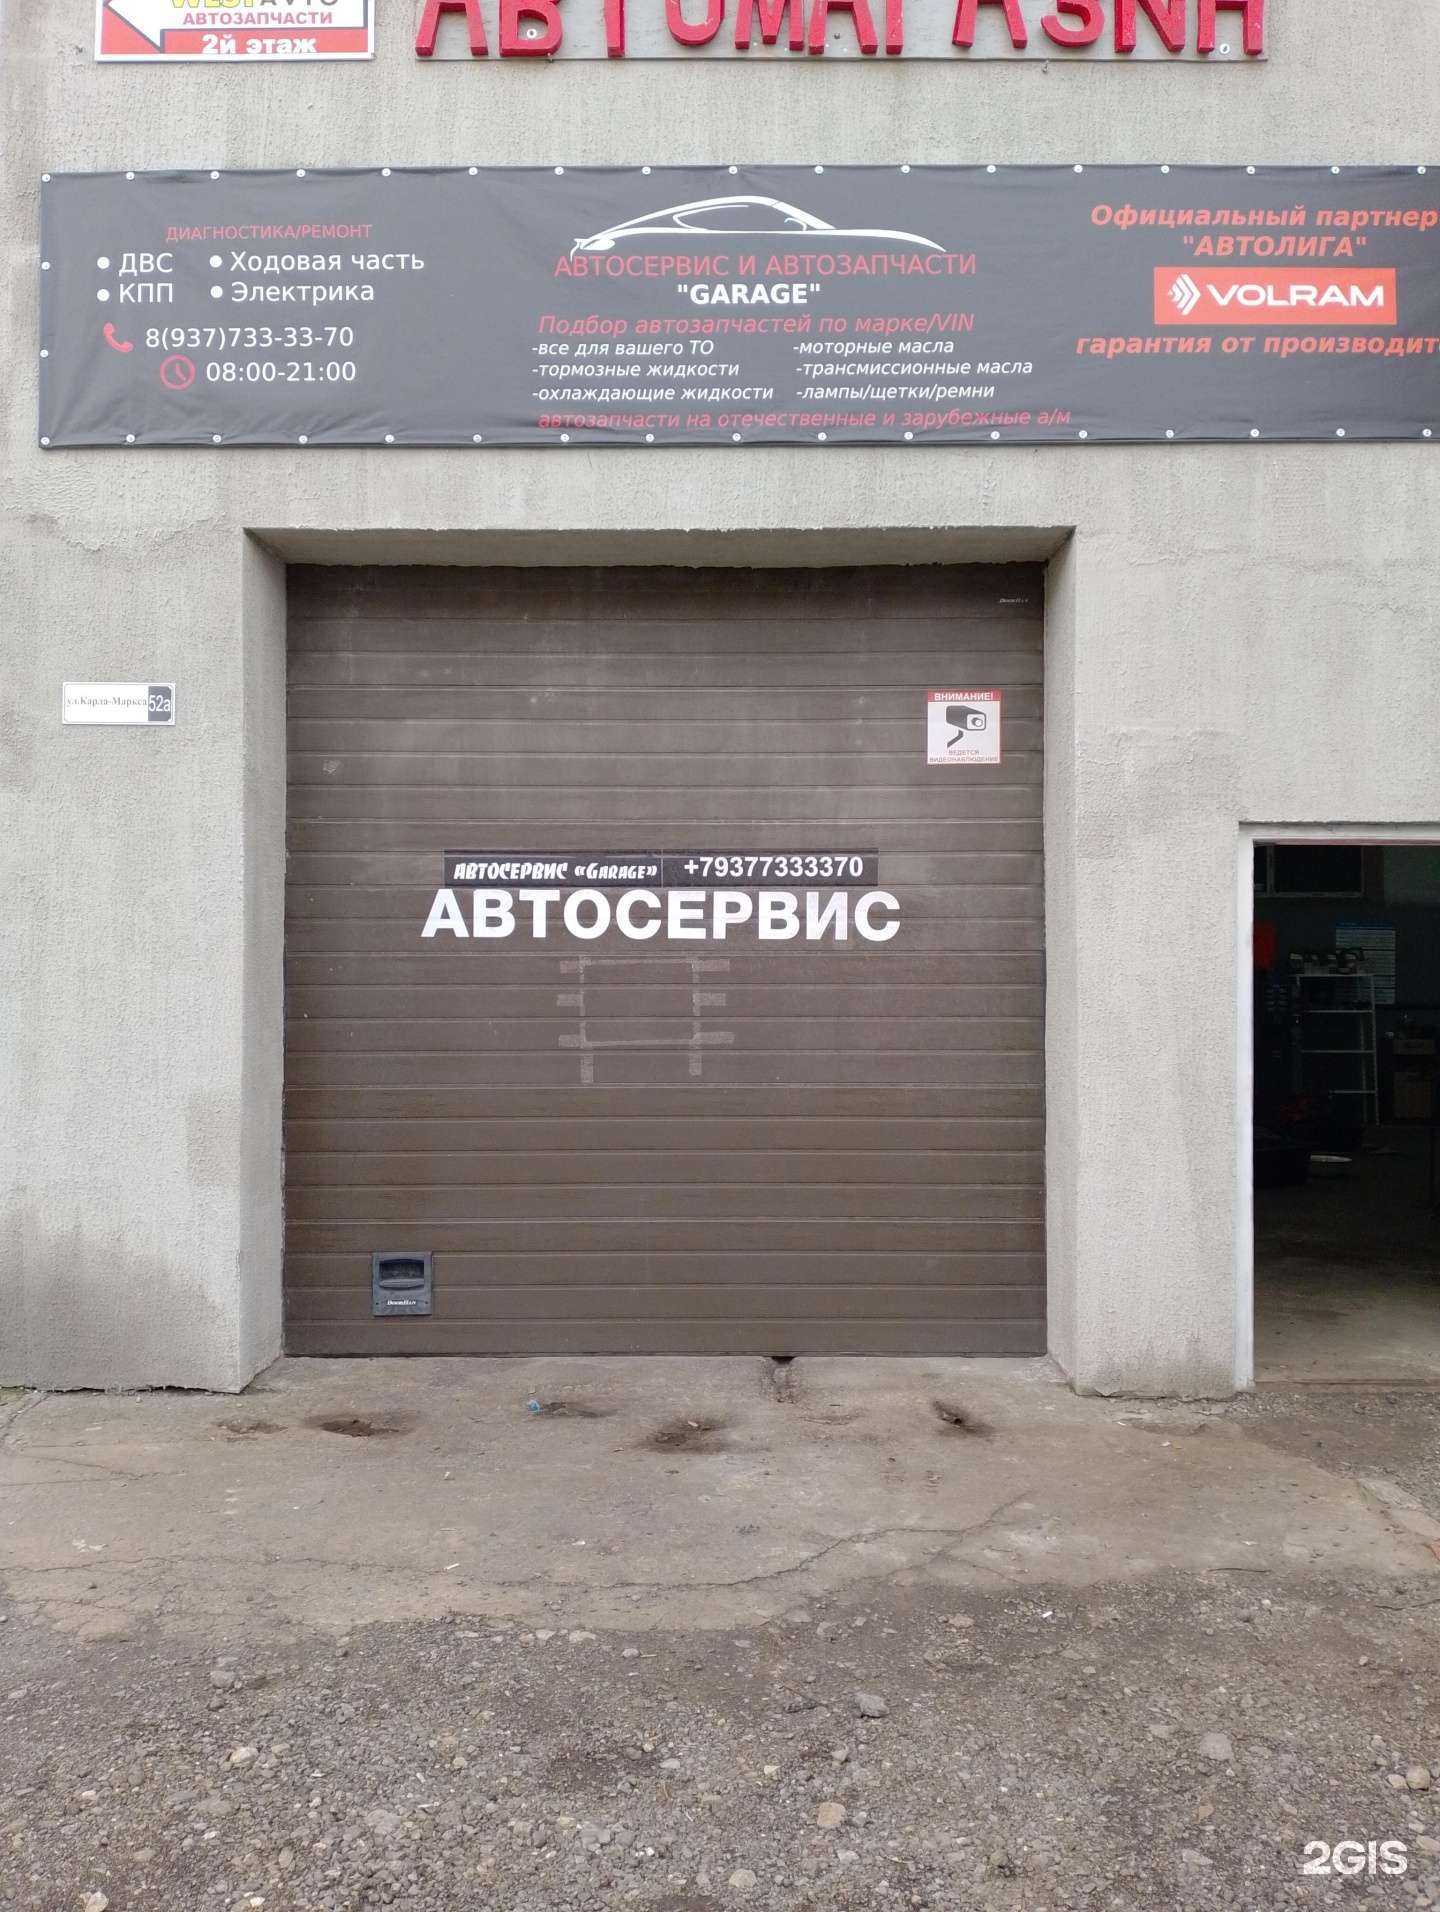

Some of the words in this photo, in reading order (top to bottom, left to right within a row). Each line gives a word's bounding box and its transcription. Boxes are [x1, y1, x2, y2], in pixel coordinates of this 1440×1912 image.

[183, 11, 333, 25] АВТОЗАПЧАСТИ
[202, 33, 236, 54] 2й
[246, 36, 317, 54] этаж
[1091, 204, 1305, 230] Официальный
[1315, 207, 1440, 230] партнер
[165, 224, 372, 242] ДИАГНОСТИКА/РЕМОНТ
[1183, 235, 1367, 257] "АВТОЛИГА"
[118, 252, 173, 276] ДВС
[230, 251, 342, 274] Ходовая
[351, 252, 425, 271] часть
[554, 255, 729, 277] АВТОСЕРВИС
[739, 255, 756, 275] И
[765, 253, 976, 276] АВТОЗАПЧАСТИ
[119, 283, 173, 303] КПП
[231, 280, 375, 306] Электрика
[677, 283, 821, 305] "GARAGE"
[1206, 284, 1384, 306] VOLRAM
[537, 315, 628, 338] Подбор
[635, 313, 812, 335] автозапчастей
[819, 318, 847, 333] по
[855, 312, 975, 336] марке/VIN
[145, 326, 354, 351] 8(937)733-33-70
[532, 342, 570, 355] -все
[575, 342, 608, 357] для
[615, 341, 684, 356] вашего
[689, 339, 714, 355] ТО
[793, 340, 893, 358] -моторные
[898, 339, 954, 354] масла
[1075, 336, 1211, 358] гарантия
[1222, 336, 1255, 354] от
[1263, 335, 1440, 358] производит
[206, 361, 356, 382] 08:00-21:00
[532, 364, 641, 380] -тормозные
[646, 362, 740, 378] жидкости
[796, 361, 971, 379] -трансмиссионные
[977, 360, 1033, 375] масла
[532, 385, 675, 402] -охлаждающие
[681, 385, 774, 402] жидкости
[796, 384, 995, 402] -лампы/щетки/ремни
[538, 412, 681, 429] автозапчасти
[686, 412, 712, 427] на
[718, 411, 876, 427] отечественные
[882, 412, 895, 426] и
[901, 408, 1031, 428] зарубежные
[1037, 408, 1071, 427] а/м
[934, 692, 994, 701] ВНИМАНИЕ!
[453, 862, 568, 880] АВТОСЕРВИС
[684, 856, 864, 878] +79377333370
[421, 889, 900, 940] АВТОСЕРВИС
